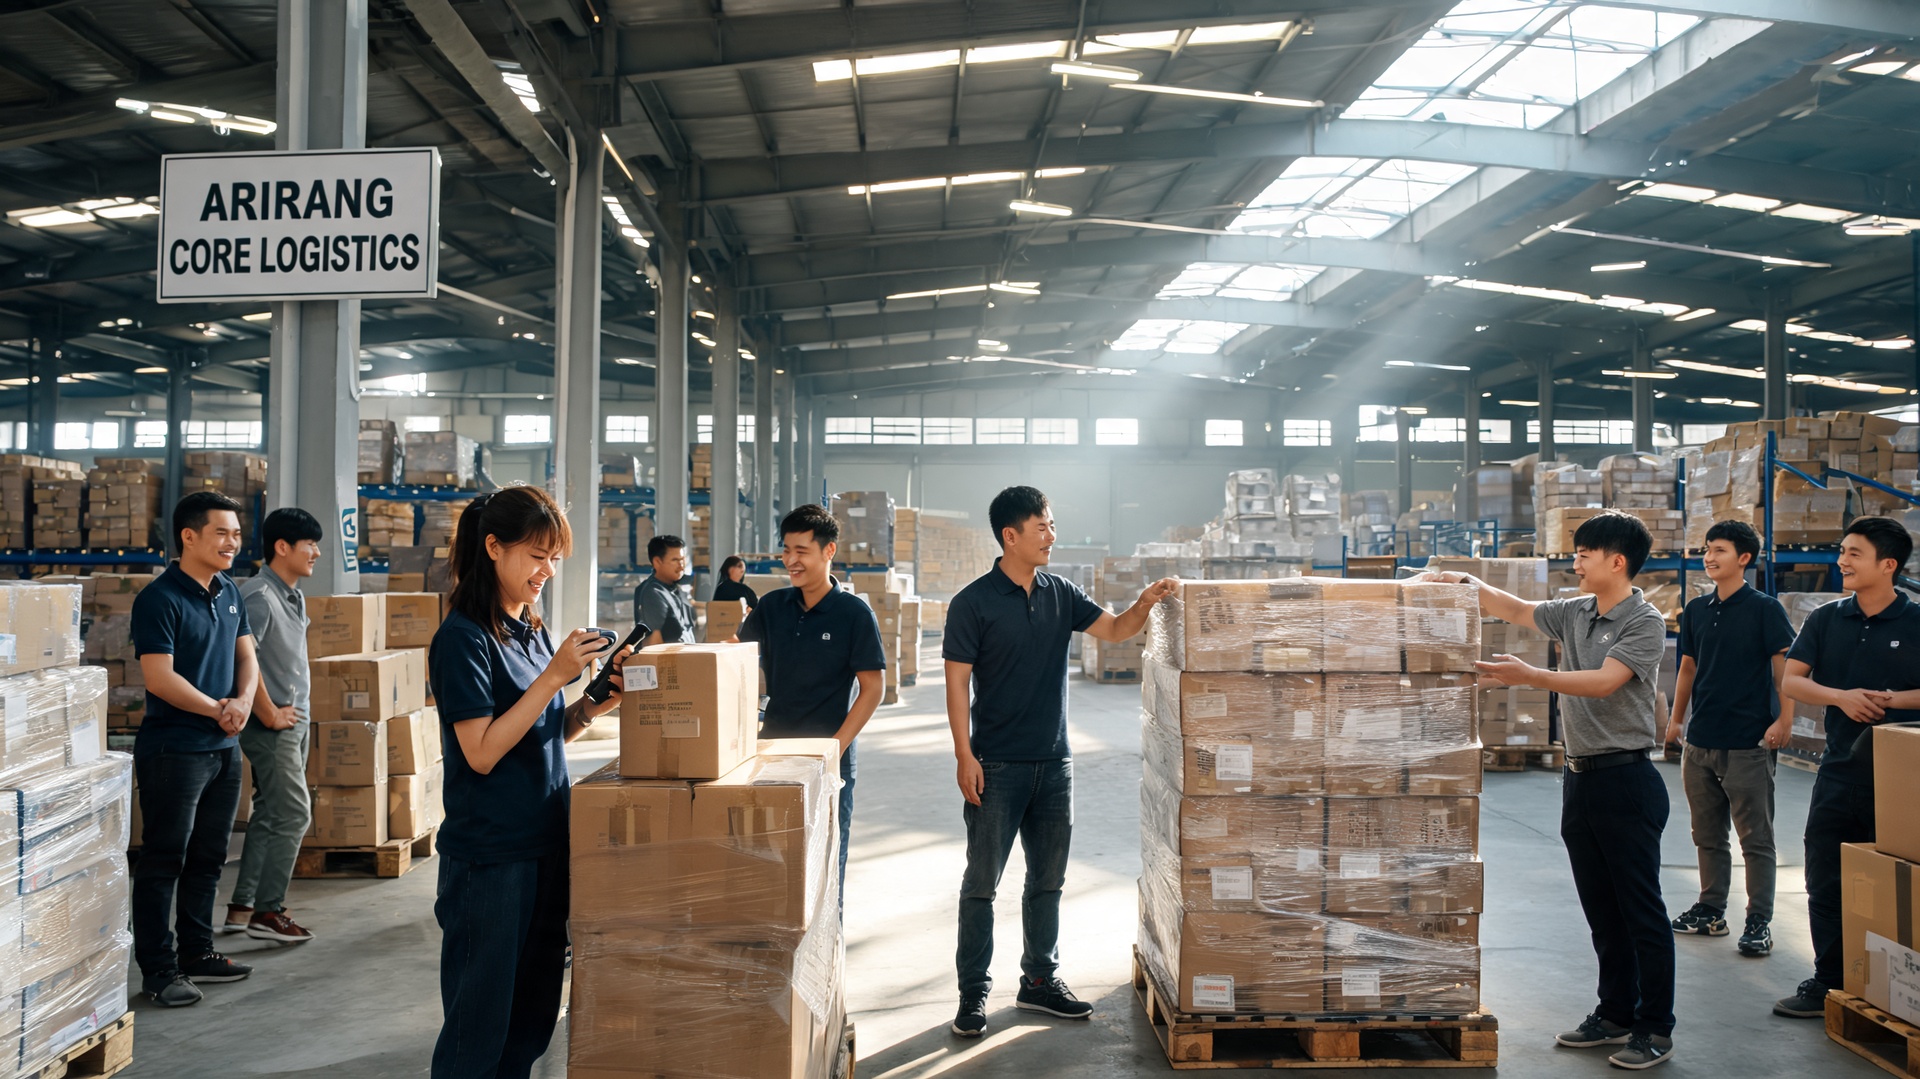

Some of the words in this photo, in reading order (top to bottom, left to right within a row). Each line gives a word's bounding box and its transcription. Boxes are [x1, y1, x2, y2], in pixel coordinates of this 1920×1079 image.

[200, 178, 393, 221] ARIRANG
[170, 238, 251, 275] CORE
[260, 234, 420, 273] LOGISTICS
